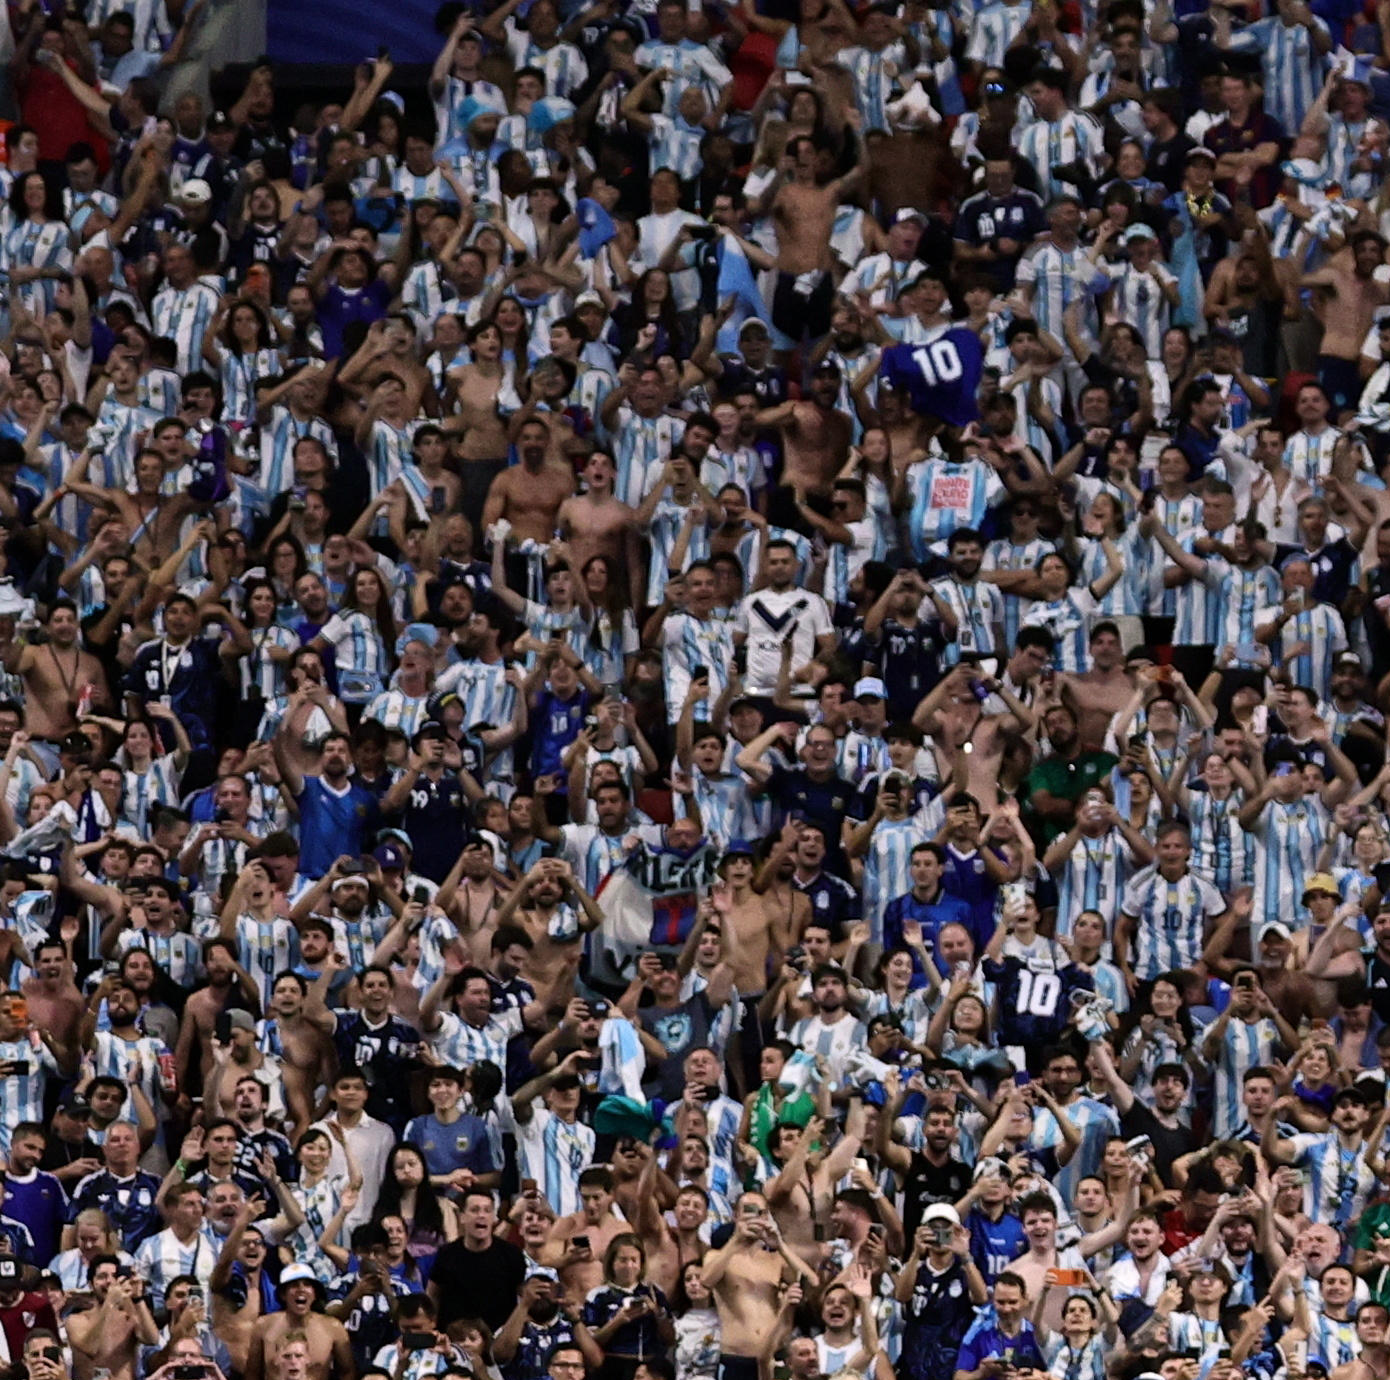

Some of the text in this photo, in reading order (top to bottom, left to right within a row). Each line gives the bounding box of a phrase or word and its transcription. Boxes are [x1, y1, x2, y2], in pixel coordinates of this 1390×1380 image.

[911, 340, 964, 387] 10
[1164, 910, 1182, 931] 10
[1016, 968, 1061, 1016] 10
